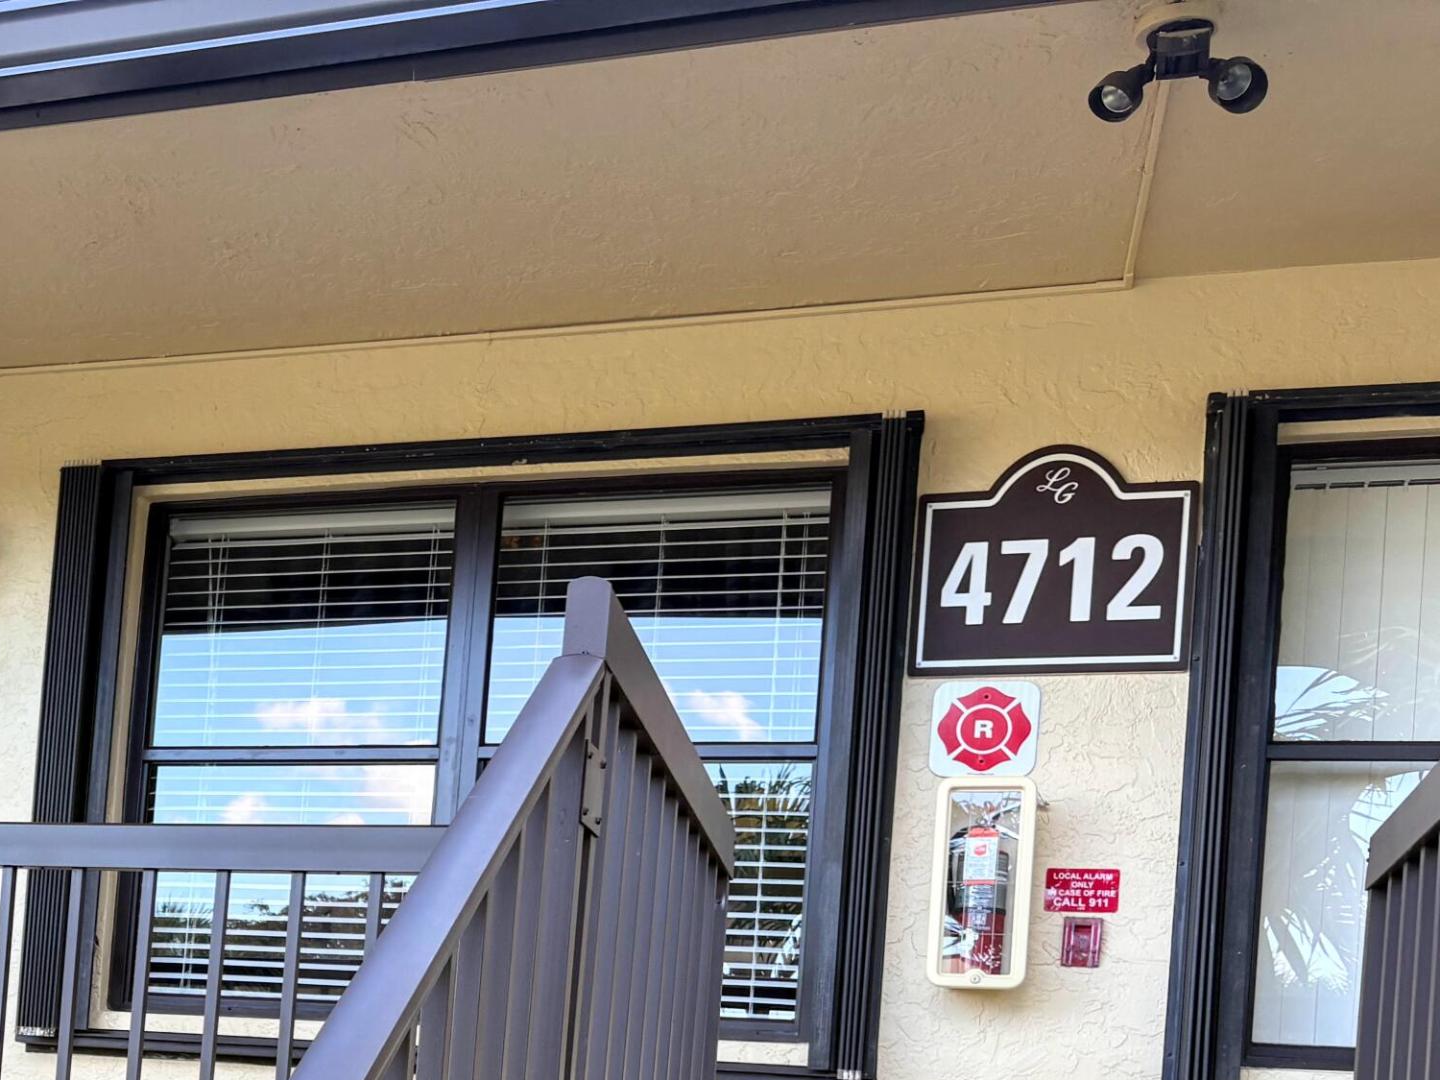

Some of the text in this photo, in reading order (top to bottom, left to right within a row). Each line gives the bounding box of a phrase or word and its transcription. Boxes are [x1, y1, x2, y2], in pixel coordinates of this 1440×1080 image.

[940, 533, 1164, 625] 4712
[973, 719, 994, 739] R
[1053, 872, 1114, 881] LOCAL ALARM
[1071, 881, 1094, 889] ONLY
[1058, 889, 1081, 897] CASE
[1083, 889, 1095, 897] OF
[1096, 889, 1117, 898] FIRE
[1053, 897, 1109, 908] CALL 911
